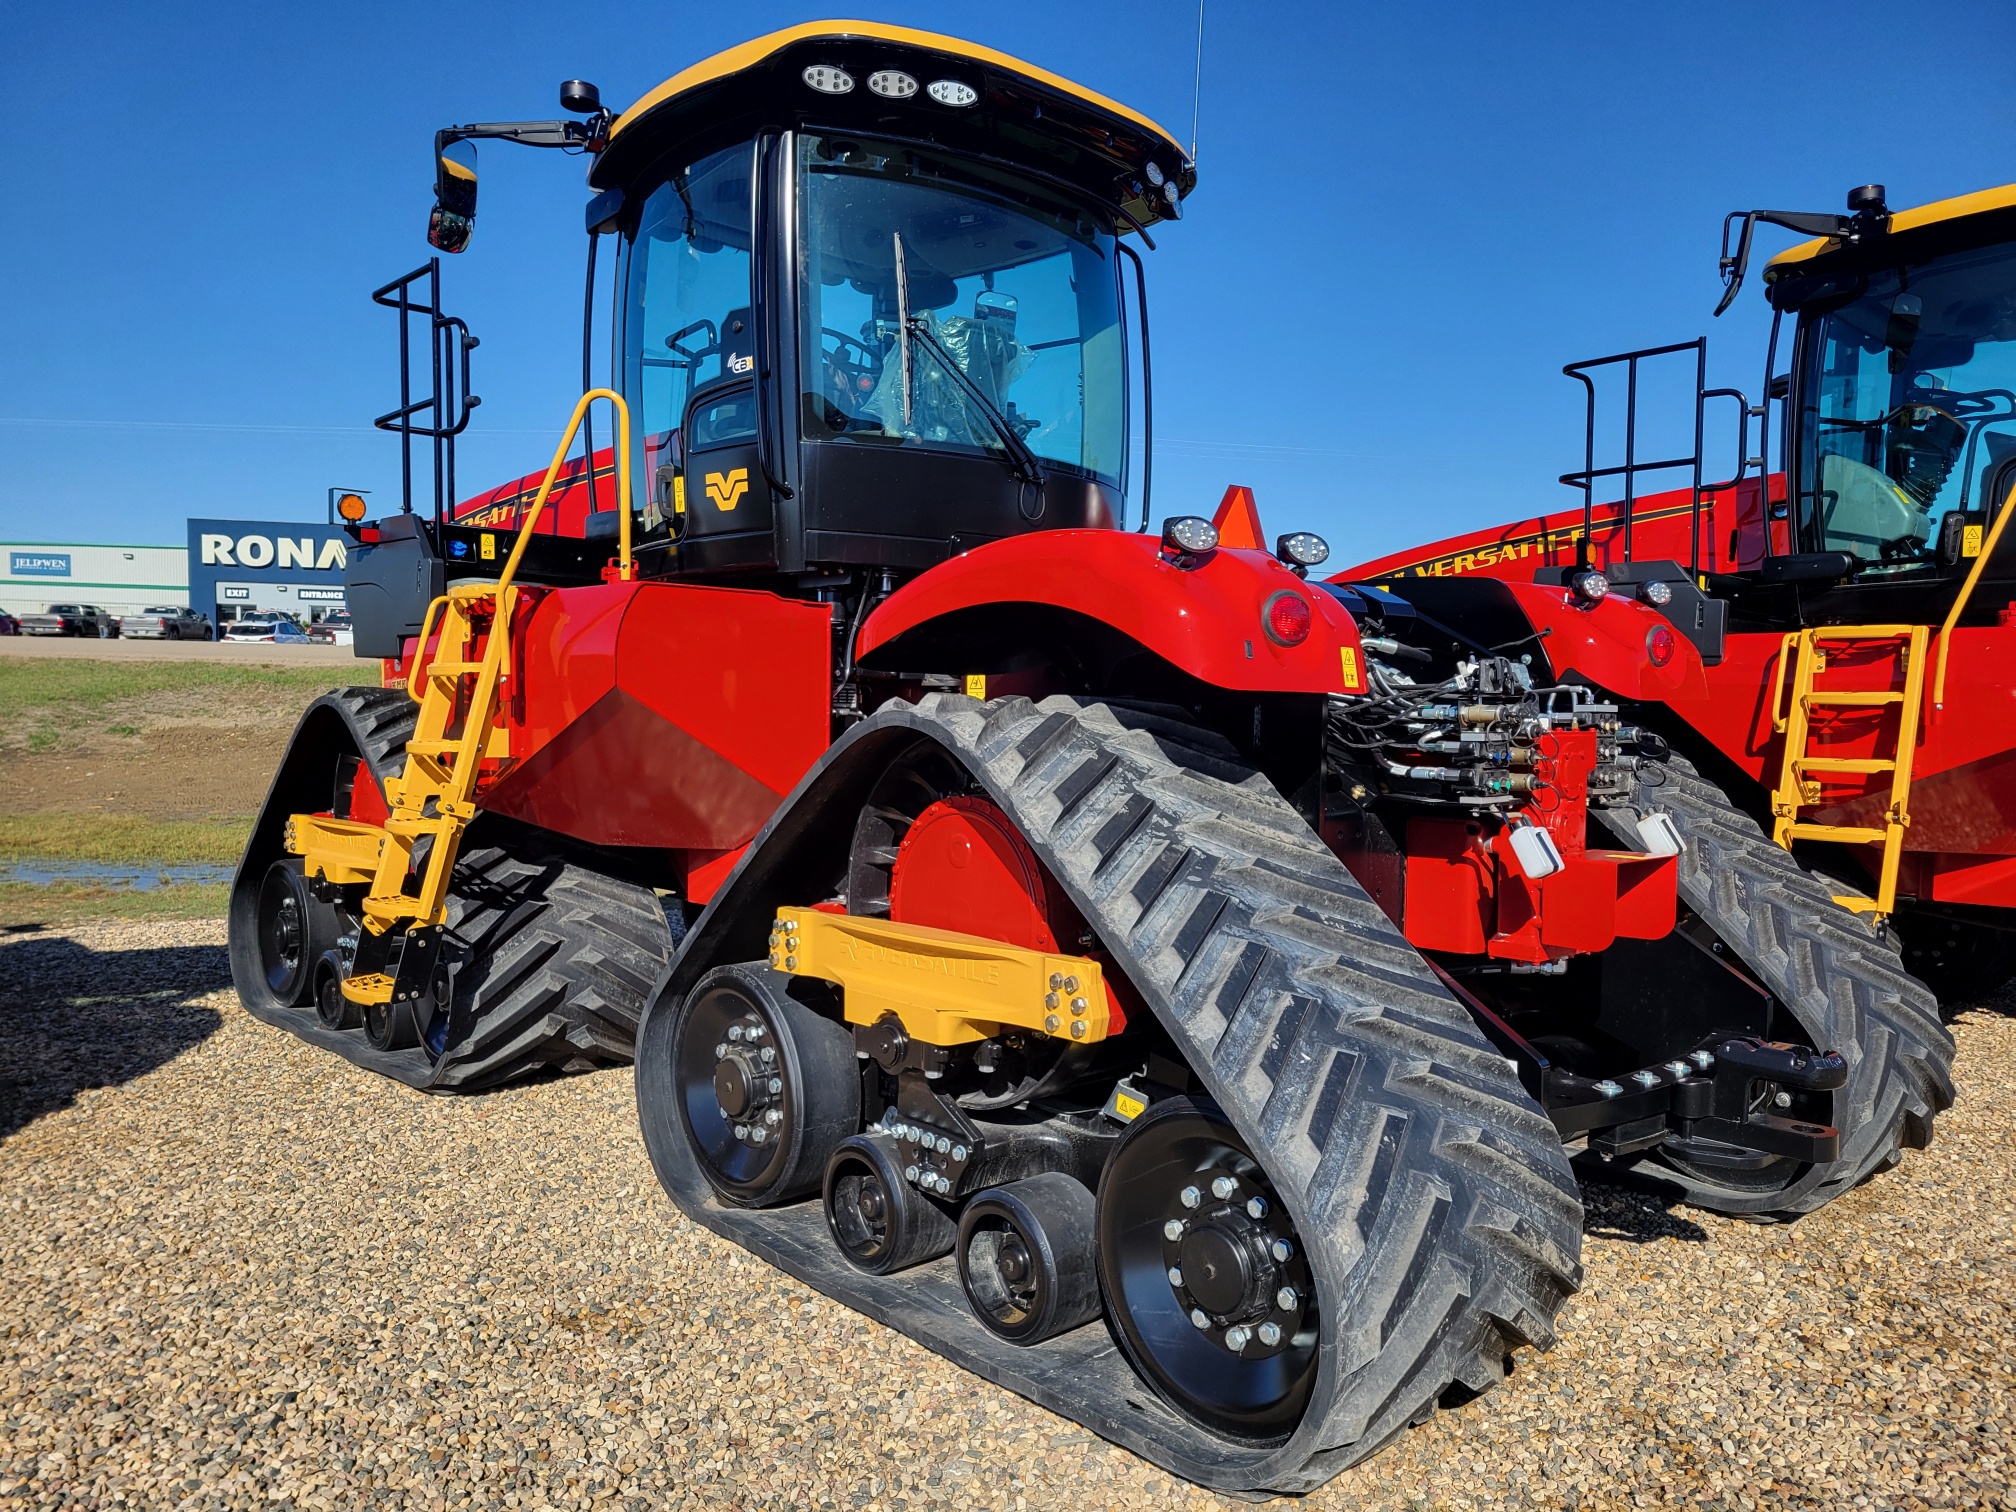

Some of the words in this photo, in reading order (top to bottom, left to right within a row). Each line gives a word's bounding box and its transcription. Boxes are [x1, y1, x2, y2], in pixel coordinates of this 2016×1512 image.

[202, 534, 347, 569] RONA
[226, 589, 248, 598] EXIT
[300, 590, 344, 599] ENTRANCE
